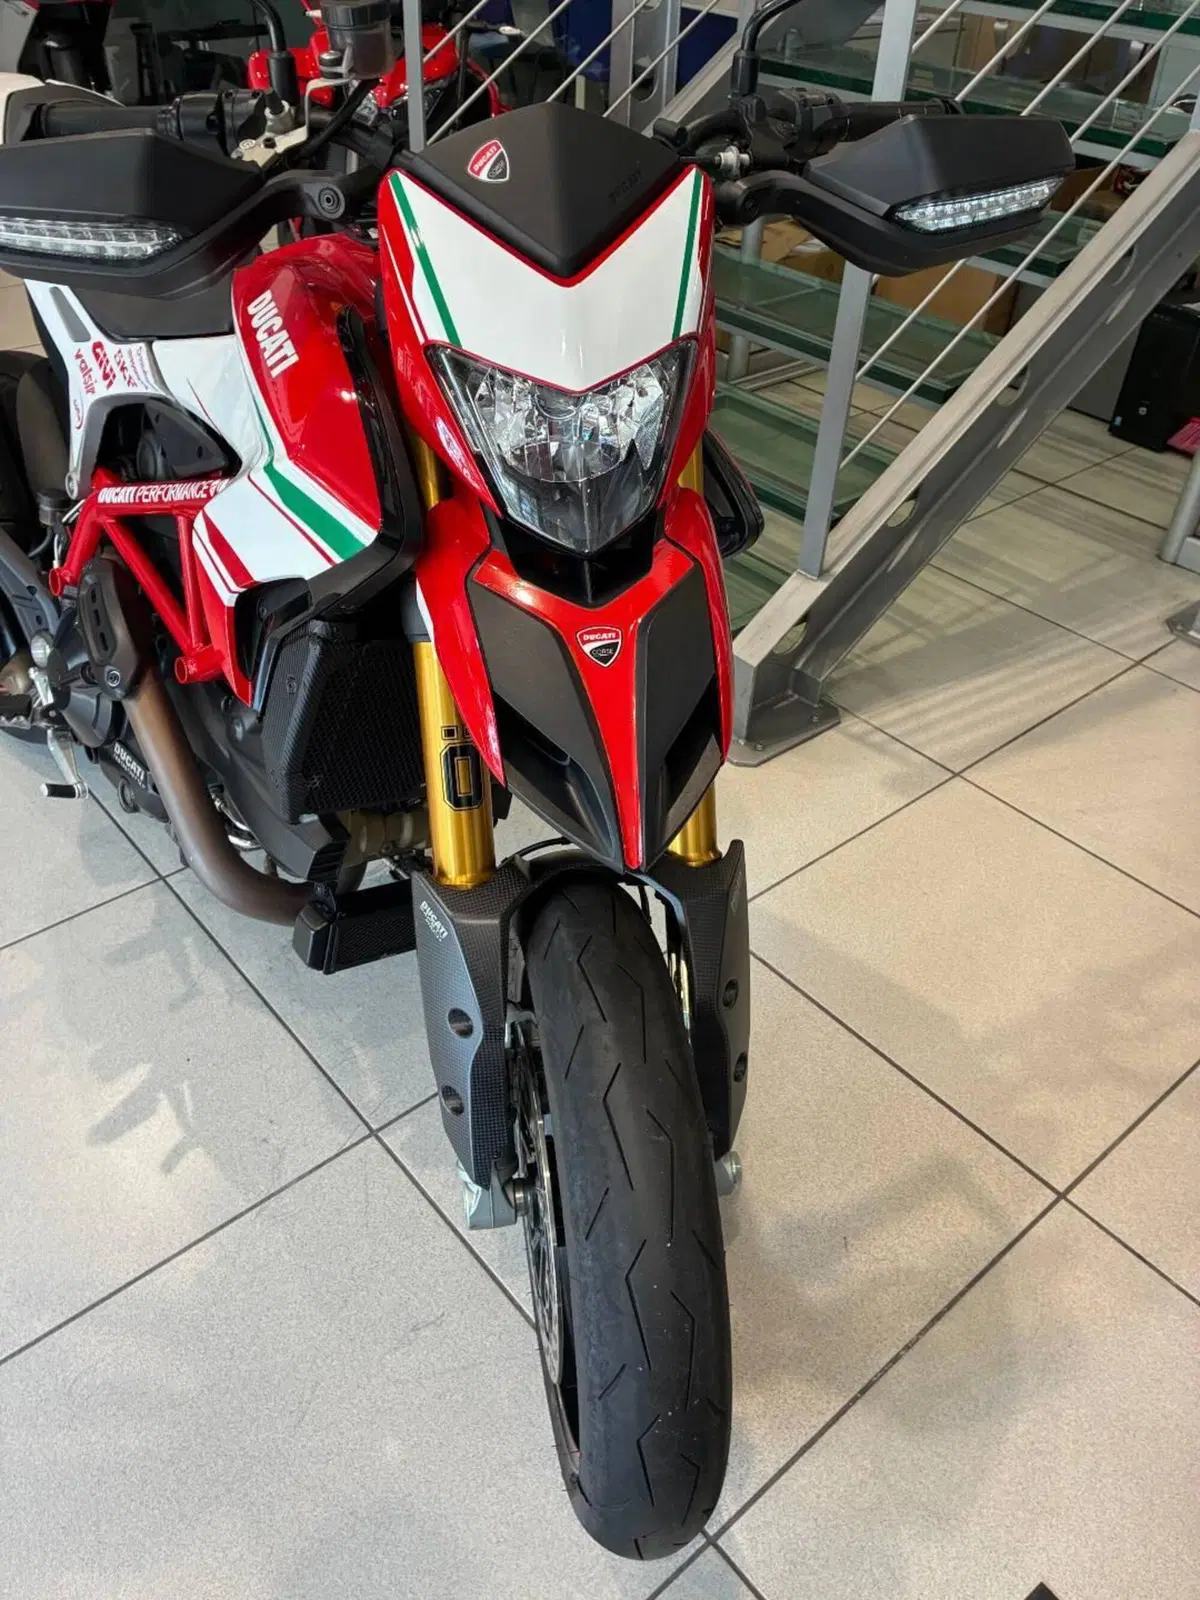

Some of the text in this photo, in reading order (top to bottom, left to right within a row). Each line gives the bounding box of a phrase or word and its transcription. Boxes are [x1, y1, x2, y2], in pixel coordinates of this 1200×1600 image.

[473, 146, 497, 172] DUCATI
[247, 289, 299, 378] DUCATI
[92, 341, 116, 390] GIVI
[97, 485, 138, 504] DUCATI
[135, 480, 210, 503] PERFORMANCE
[583, 632, 617, 641] DUCATI
[113, 742, 145, 781] DUCATI
[420, 900, 449, 939] DUCATI
